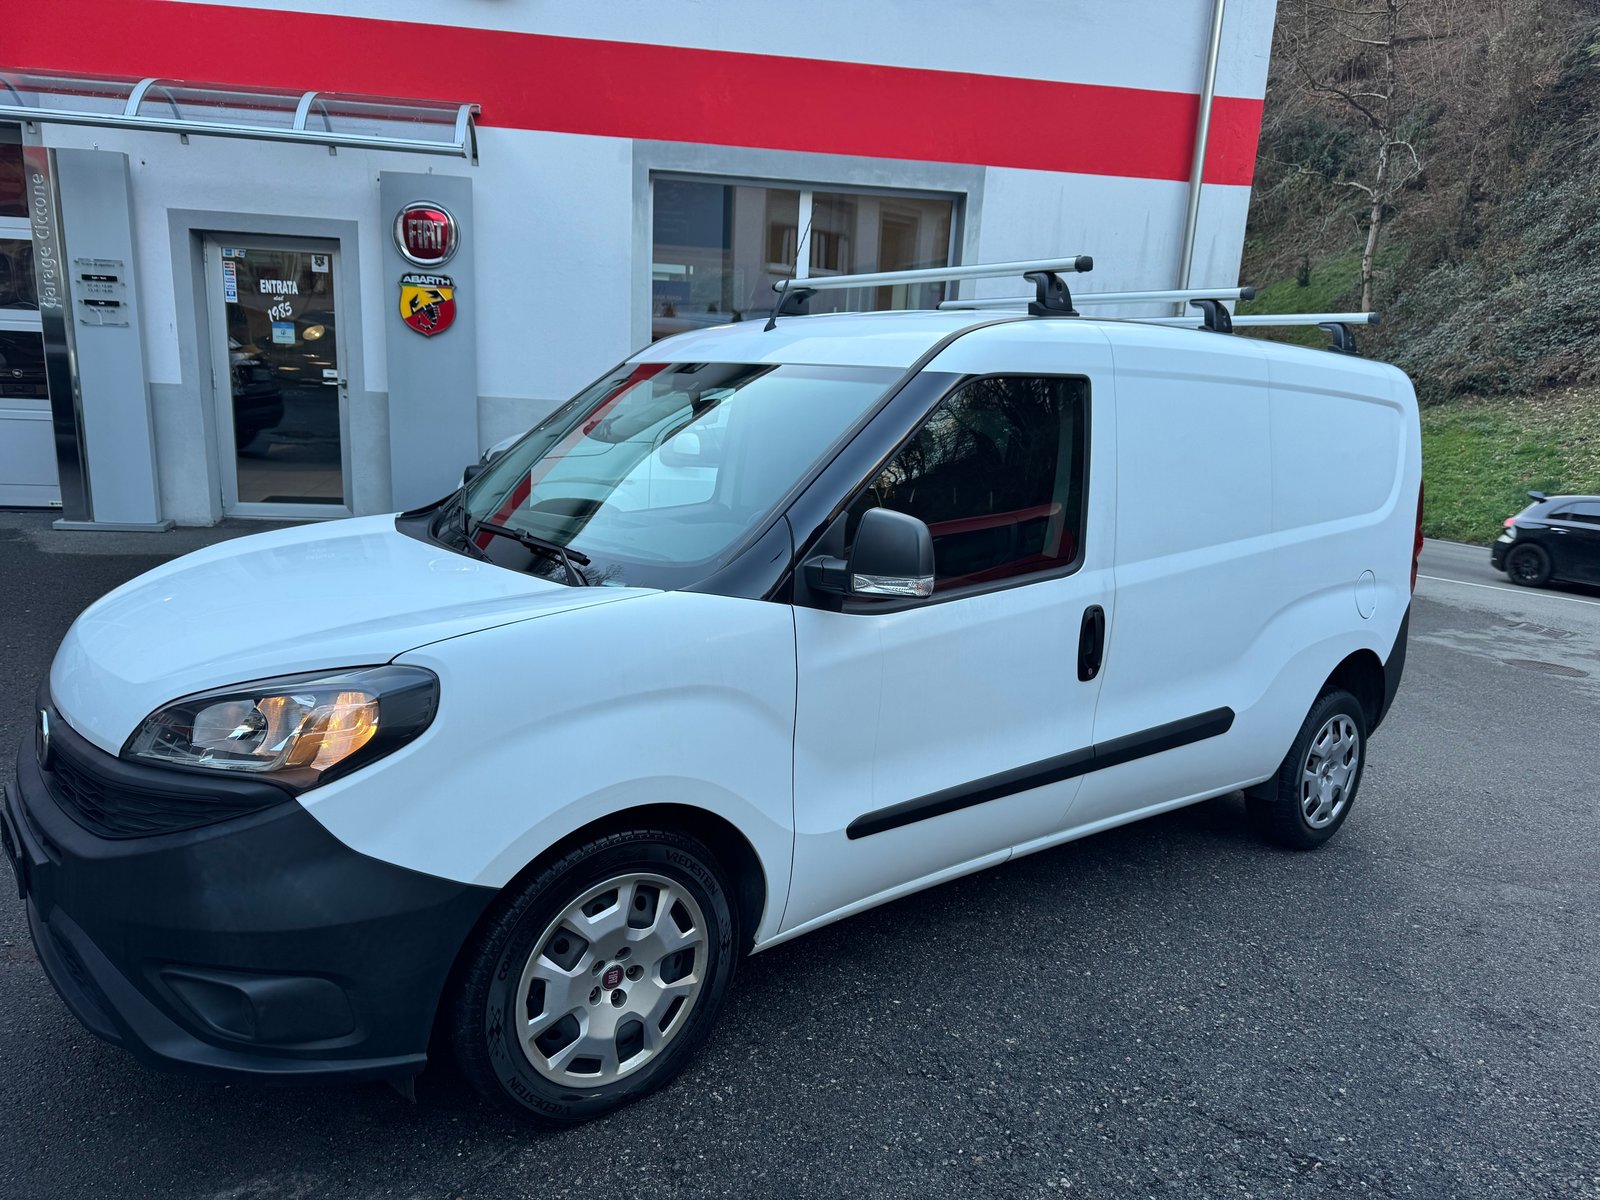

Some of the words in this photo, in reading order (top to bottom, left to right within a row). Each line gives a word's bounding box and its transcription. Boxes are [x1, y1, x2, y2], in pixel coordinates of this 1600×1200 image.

[32, 173, 50, 240] Ciccone
[407, 219, 444, 249] FIAT
[40, 246, 59, 309] Garage
[259, 279, 299, 295] ENTRATA
[403, 276, 450, 285] ABARTH
[267, 301, 293, 323] 1985
[665, 849, 719, 897] VREDESTEIN
[607, 969, 619, 985] FIAT
[507, 1076, 572, 1115] VREDESTEIN
